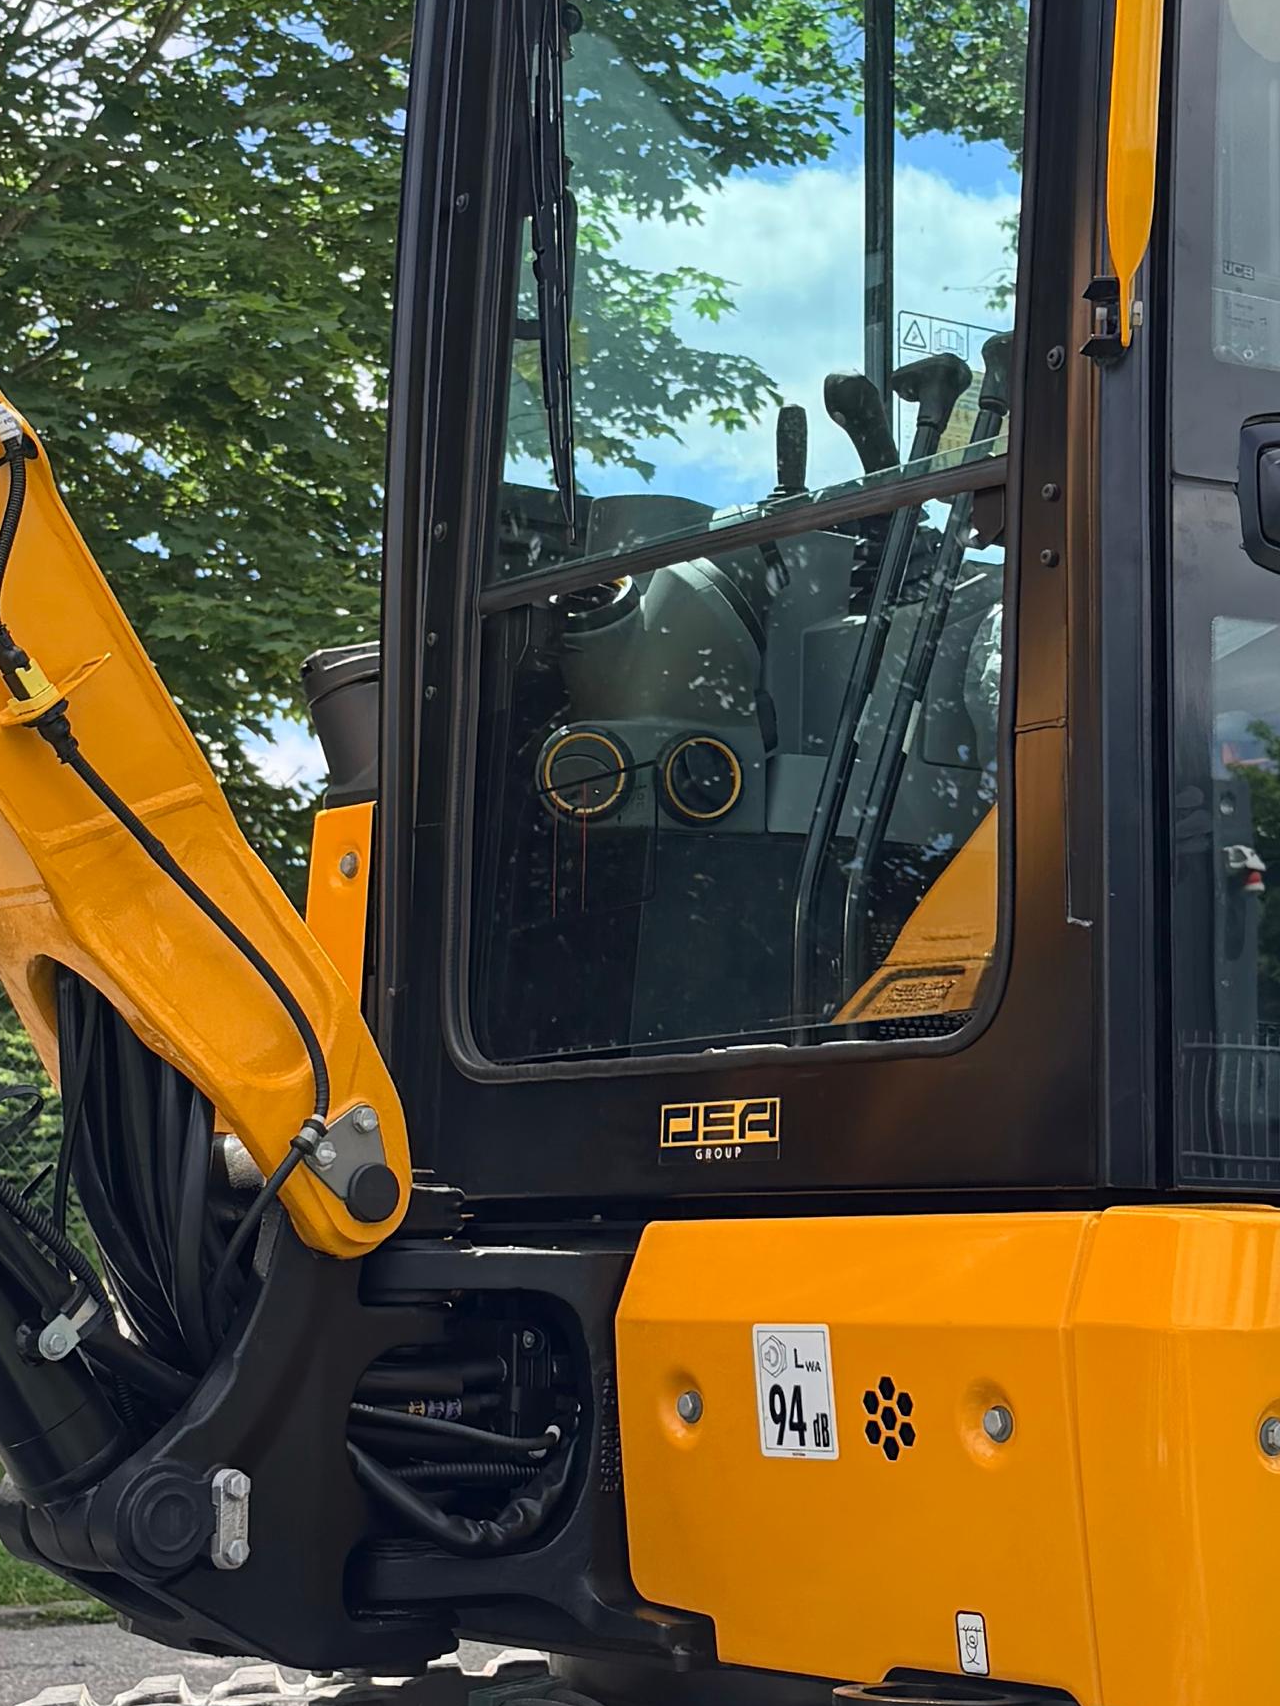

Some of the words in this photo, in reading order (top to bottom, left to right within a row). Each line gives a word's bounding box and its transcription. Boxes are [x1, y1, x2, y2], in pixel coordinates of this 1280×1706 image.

[695, 1146, 742, 1160] GROUP
[769, 1383, 807, 1447] 94
[813, 1412, 830, 1447] dB
